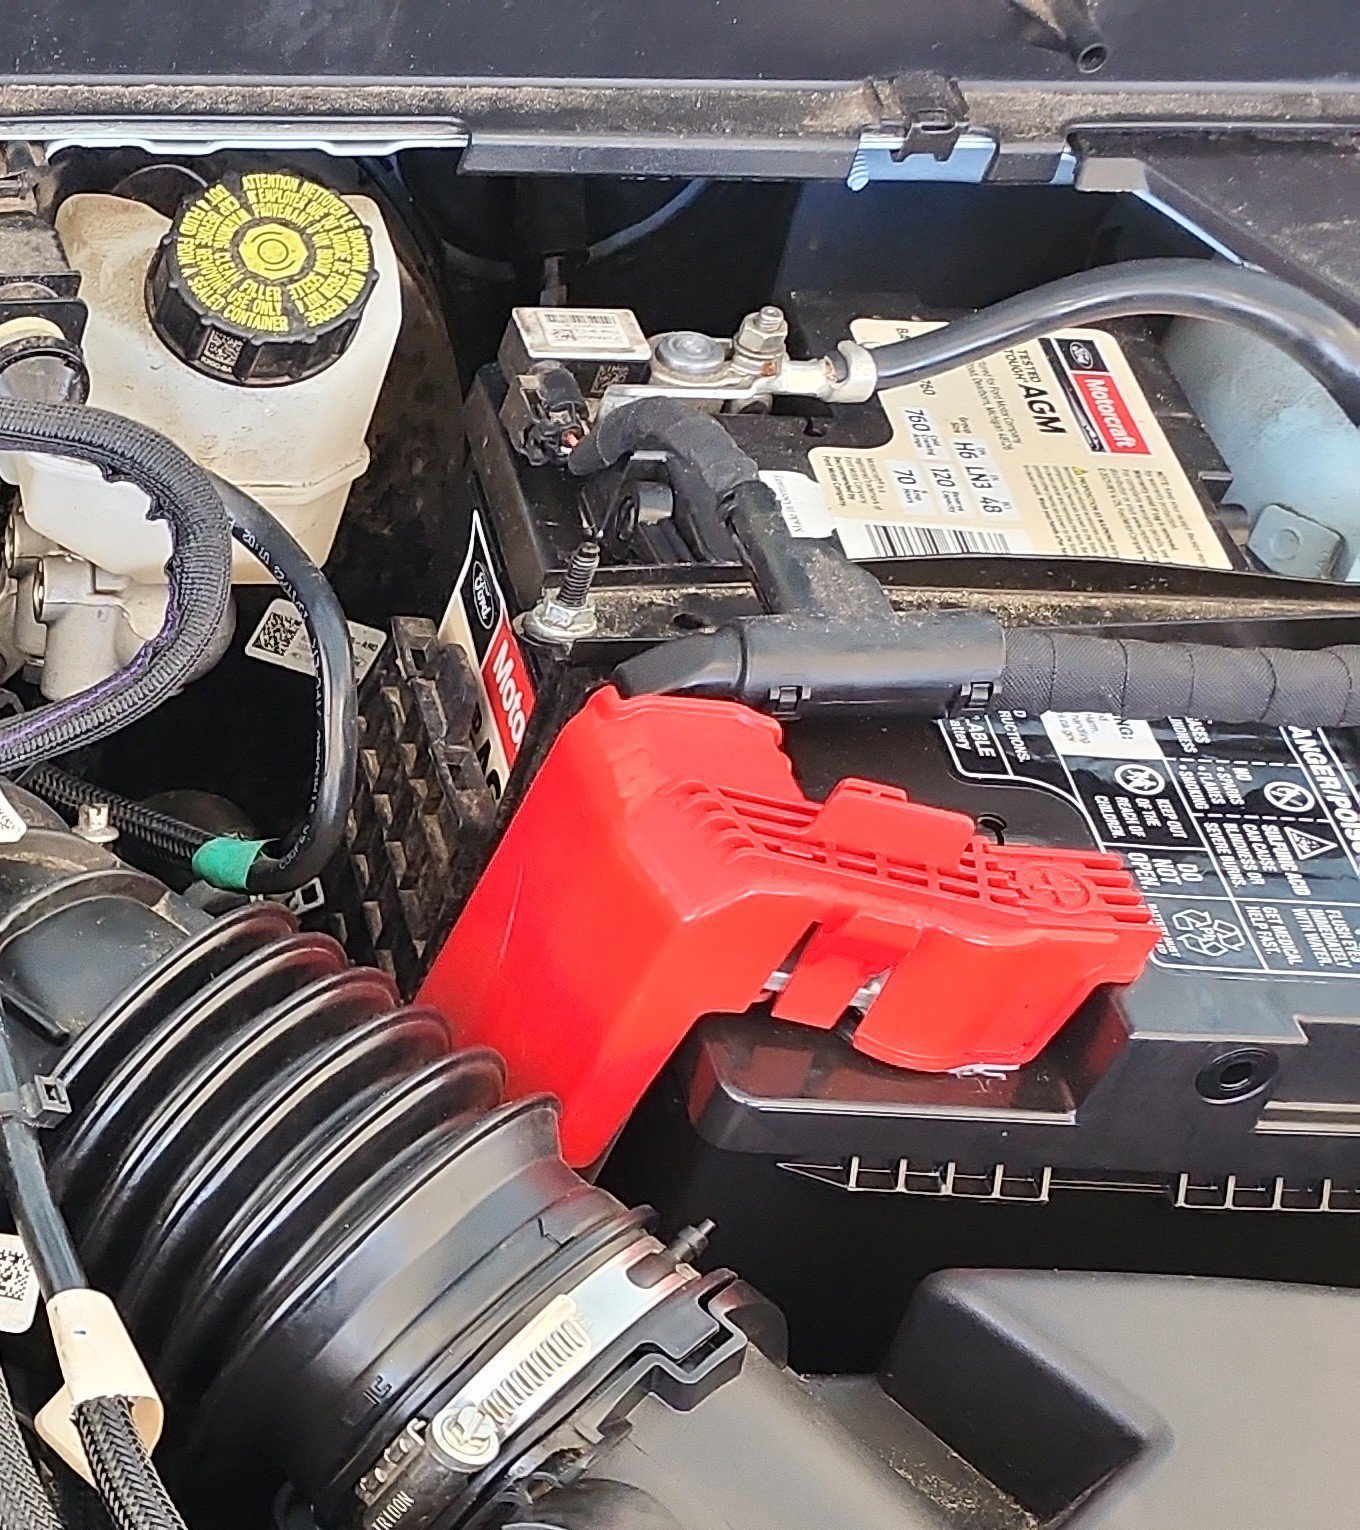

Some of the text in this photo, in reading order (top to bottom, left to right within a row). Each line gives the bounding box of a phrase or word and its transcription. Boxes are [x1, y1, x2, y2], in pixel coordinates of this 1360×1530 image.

[304, 199, 330, 220] QUE
[319, 213, 341, 230] DU
[176, 182, 289, 331] DOT 4 FLUID FROM A SEALED CONTAINER
[191, 194, 282, 315] CAP BEFORE REMOVING USE ONLY
[210, 207, 282, 301] WARNING CLEAN FILLER
[240, 173, 368, 326] ATTENTION NETTOYER LE BOUCHON AVANT DEPOSE
[250, 202, 319, 228] PROVENANT
[311, 247, 334, 275] BIDON
[330, 262, 352, 275] DE
[302, 290, 327, 310] DOT
[1016, 350, 1042, 382] TESTED
[988, 386, 1003, 398] Ford
[994, 400, 1011, 416] Motor
[1017, 384, 1067, 432] AGM
[904, 409, 932, 431] 760
[1001, 418, 1024, 443] Company
[1083, 379, 1139, 446] Motorcraft
[892, 470, 917, 484] 70
[929, 468, 956, 486] 120
[953, 442, 1003, 512] H6 LN3 48
[940, 491, 958, 512] Capacity
[1177, 770, 1209, 809] SMOKING
[1197, 772, 1226, 803] FLAMES
[1215, 773, 1245, 804] SPARKS
[1231, 767, 1253, 780] NO
[1093, 795, 1127, 838] CHILDREN.
[1113, 797, 1146, 837] REACH OF
[1134, 798, 1162, 826] OF THE
[1155, 798, 1188, 838] KEEP OUT
[1202, 822, 1248, 887] SEVERE BURNS.
[1221, 822, 1266, 884] BLINDNESS OR
[1241, 824, 1278, 871] CAN CAUSE
[1260, 824, 1312, 895] SULFURIC ACID
[1125, 852, 1163, 889] OPEN.
[1150, 858, 1182, 884] NOT
[1175, 863, 1204, 881] DO
[1162, 936, 1180, 957] MUST
[1244, 906, 1281, 954] HELP FAST.
[1261, 906, 1305, 965] GET MEDICAL
[1290, 908, 1334, 966] WITH WATER.
[1307, 909, 1351, 967] IMMEDIATELY
[1325, 910, 1360, 962] FLUSH EYES
